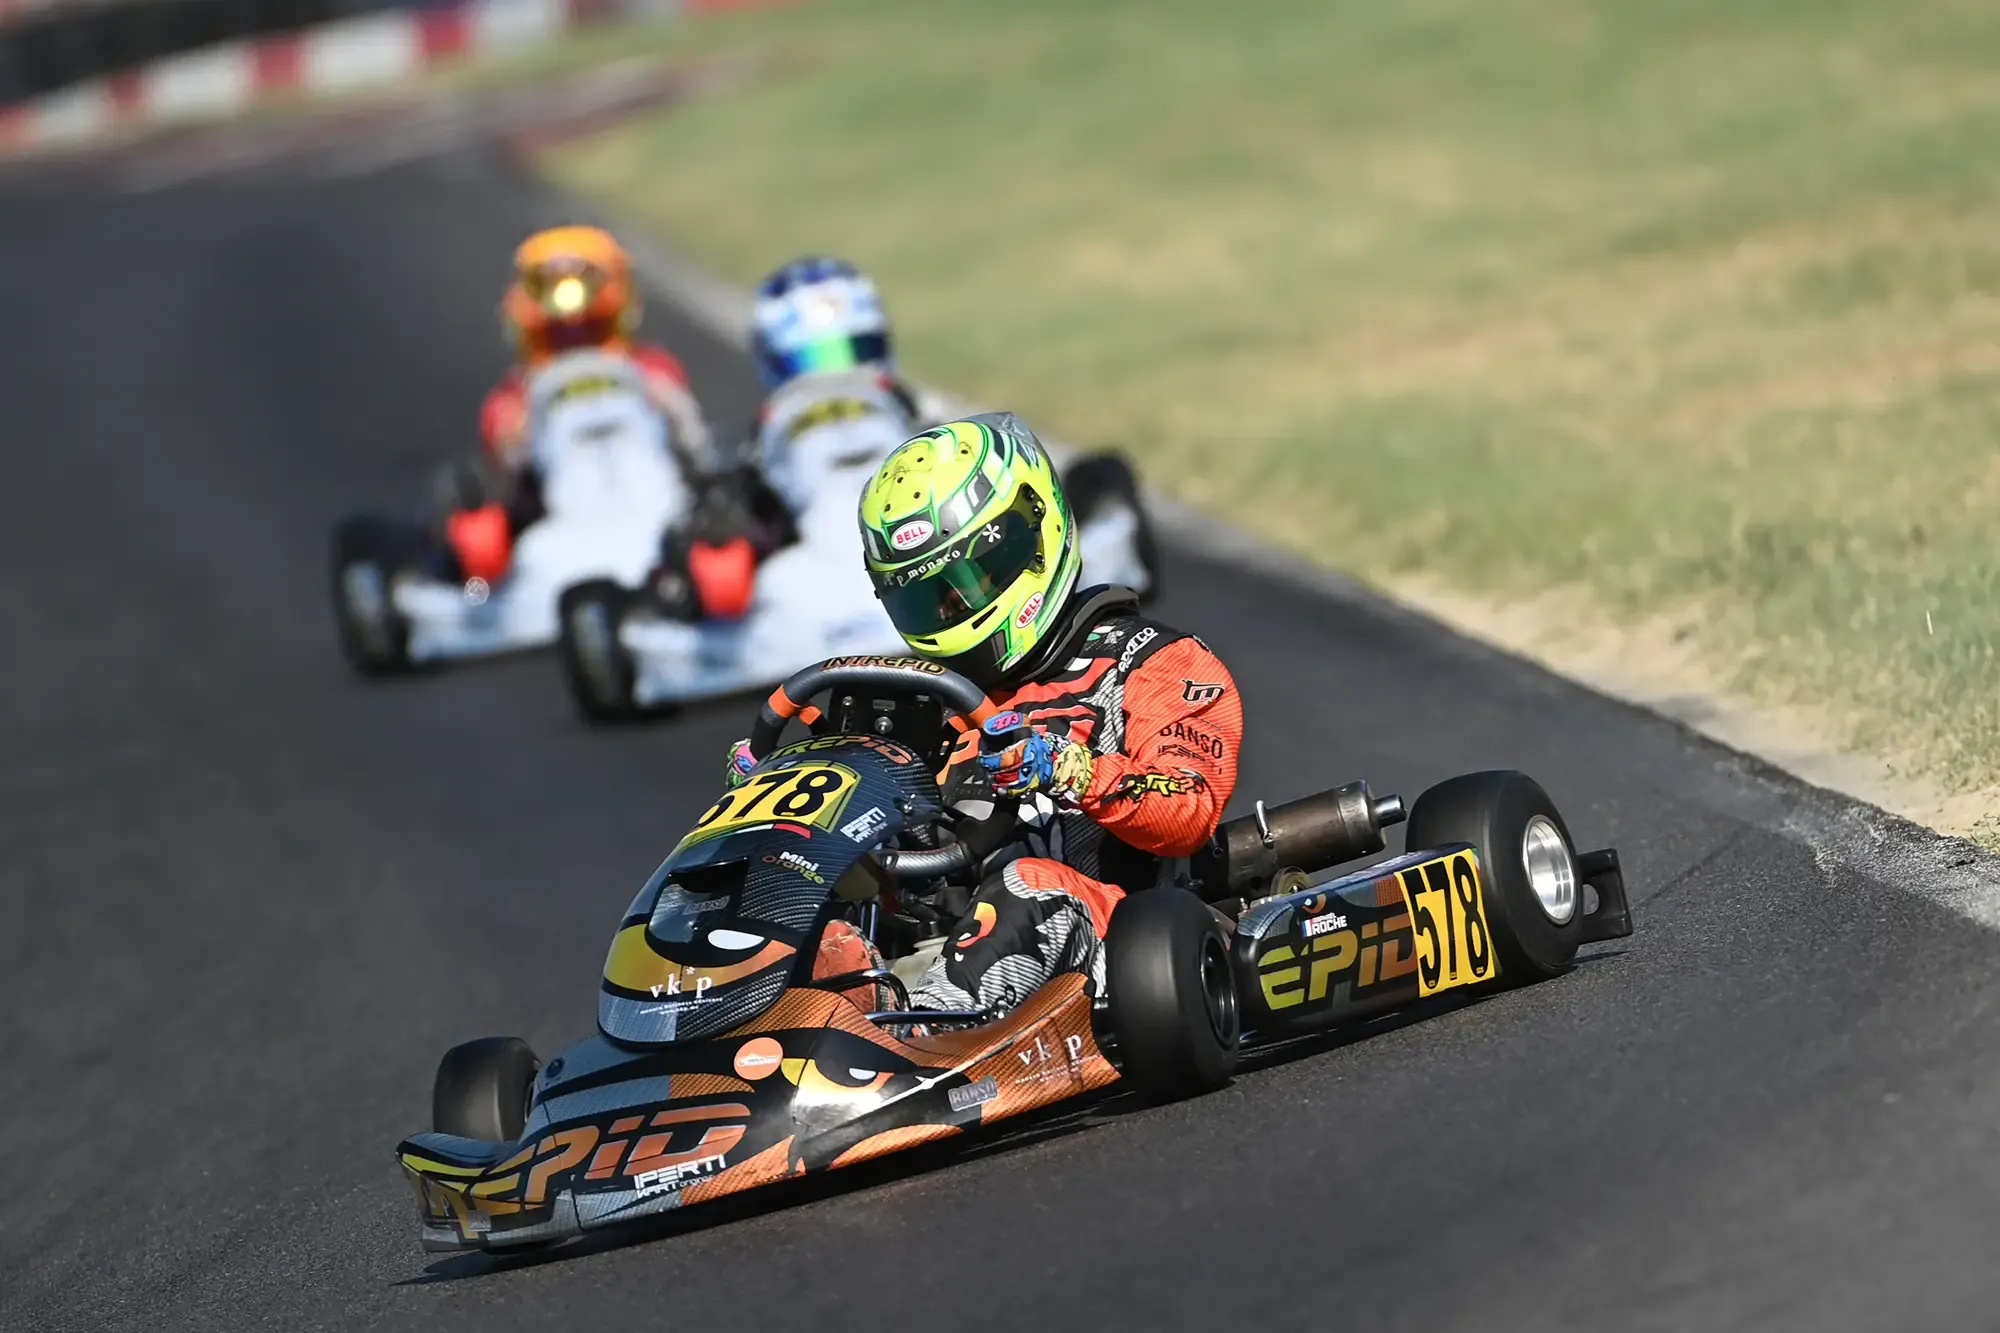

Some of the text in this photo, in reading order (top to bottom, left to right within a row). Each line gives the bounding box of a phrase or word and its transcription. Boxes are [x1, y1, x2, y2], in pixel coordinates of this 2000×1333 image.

[896, 527, 926, 544] BELL
[907, 550, 961, 579] monaco
[1019, 598, 1041, 624] BELL
[1118, 627, 1158, 672] sparco
[821, 656, 947, 676] INTREPID
[762, 855, 825, 884] Orange
[779, 851, 820, 872] Mini
[1311, 915, 1348, 935] ROCHE
[1400, 855, 1489, 990] 578
